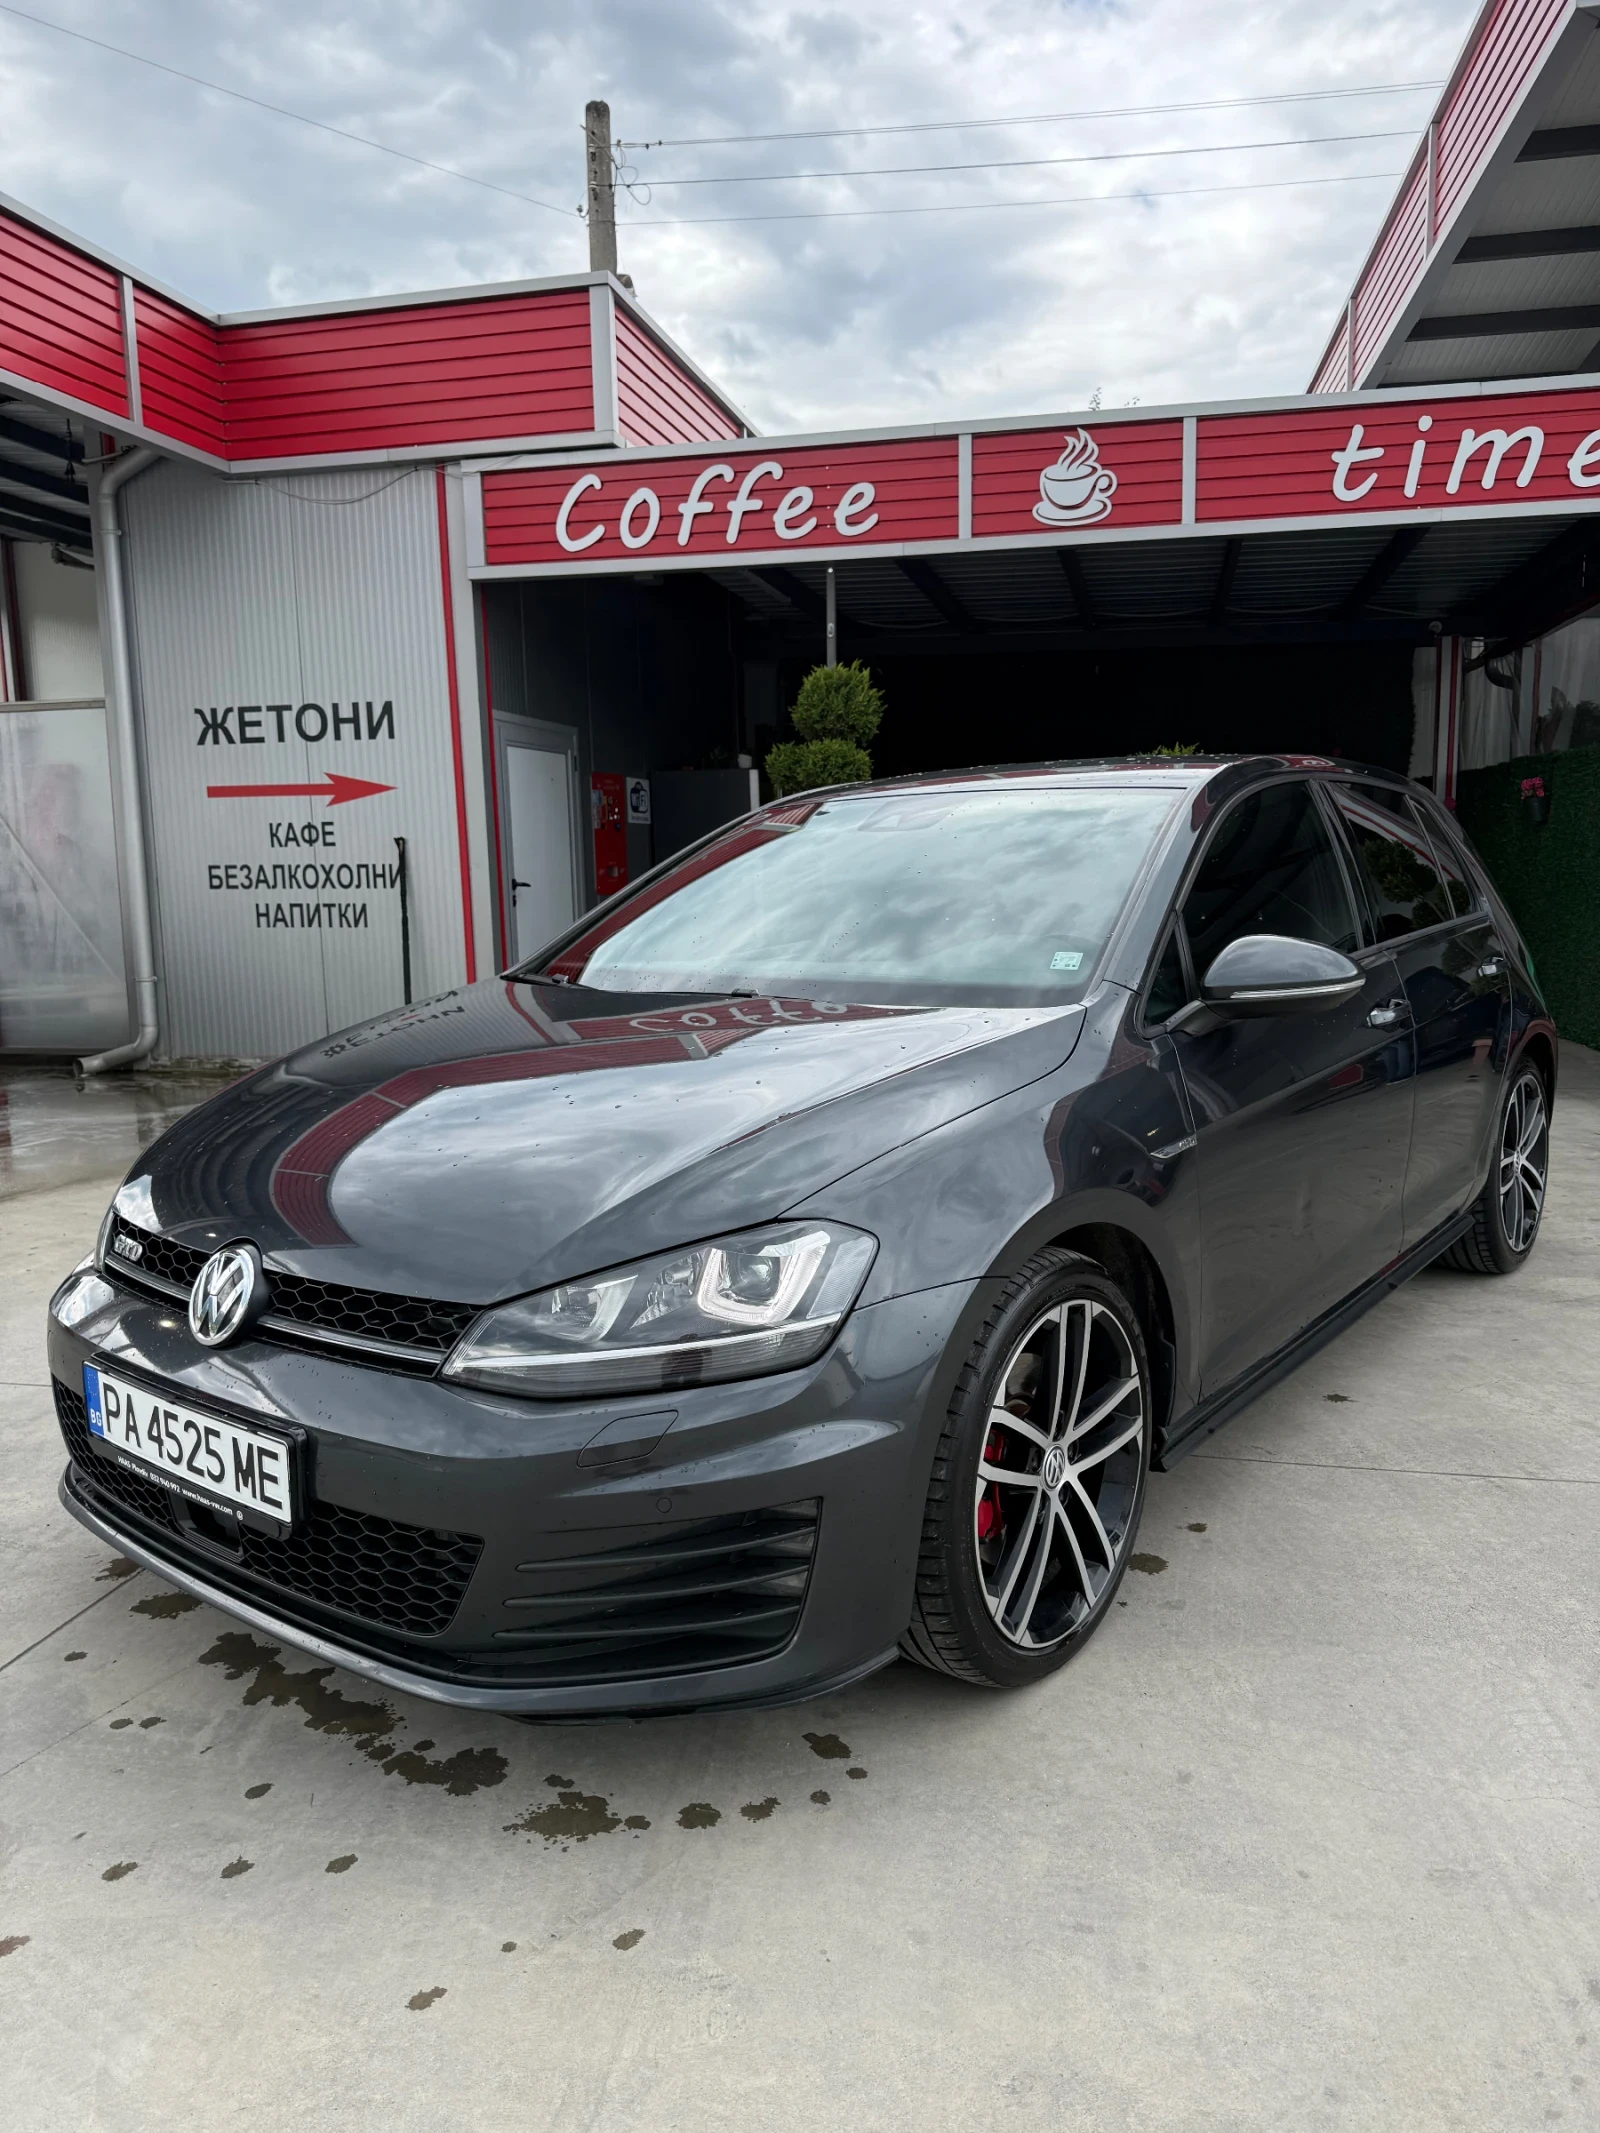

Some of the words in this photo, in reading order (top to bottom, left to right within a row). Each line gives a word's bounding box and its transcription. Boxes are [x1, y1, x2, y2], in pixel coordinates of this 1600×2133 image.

[555, 461, 879, 552] Coffee
[1331, 415, 1600, 502] time
[194, 700, 396, 746] ЖЕТОНИ
[269, 822, 336, 848] КАФЕ
[255, 902, 369, 928] НАПИТКИ
[90, 1408, 102, 1427] BG
[103, 1382, 141, 1449] PA
[147, 1405, 226, 1484] 4525
[232, 1436, 284, 1511] ME
